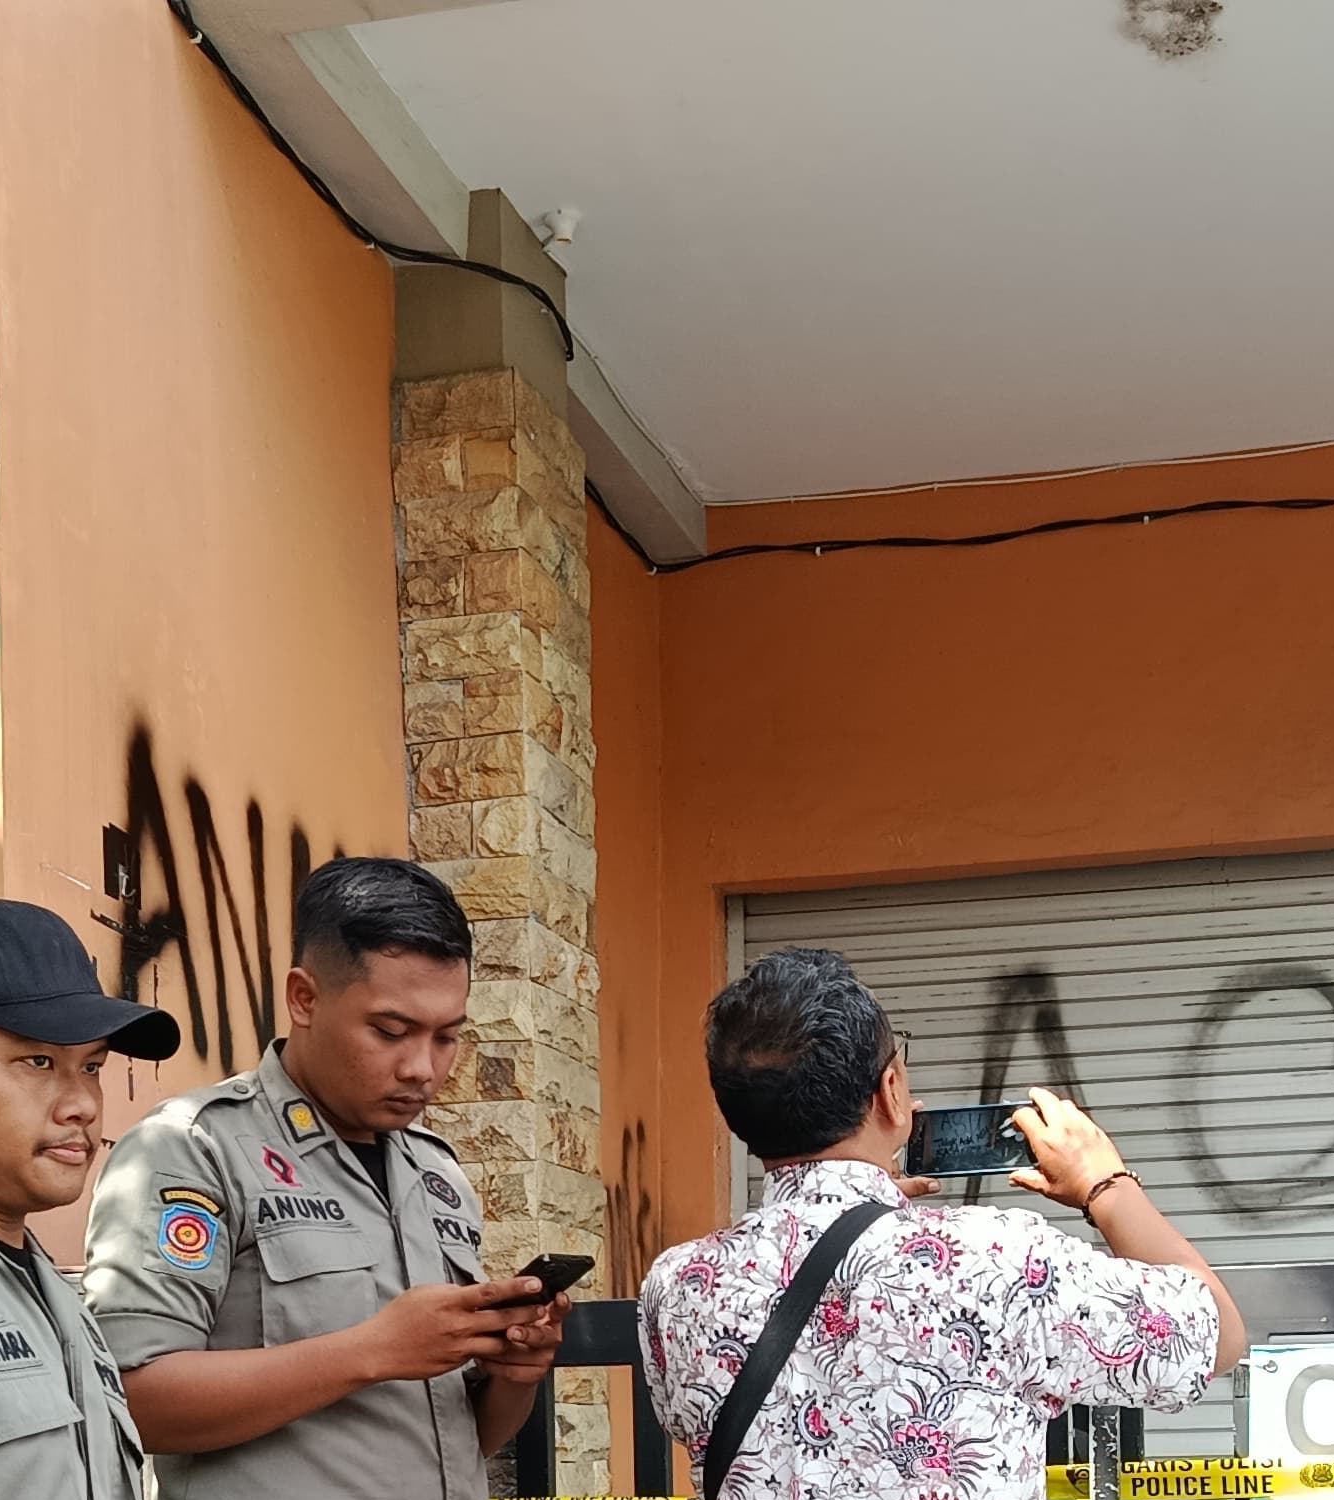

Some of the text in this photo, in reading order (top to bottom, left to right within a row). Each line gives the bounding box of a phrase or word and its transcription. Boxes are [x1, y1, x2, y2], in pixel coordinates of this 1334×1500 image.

[258, 1197, 346, 1225] ANUNG
[1131, 1474, 1274, 1497] POLICE LINE
